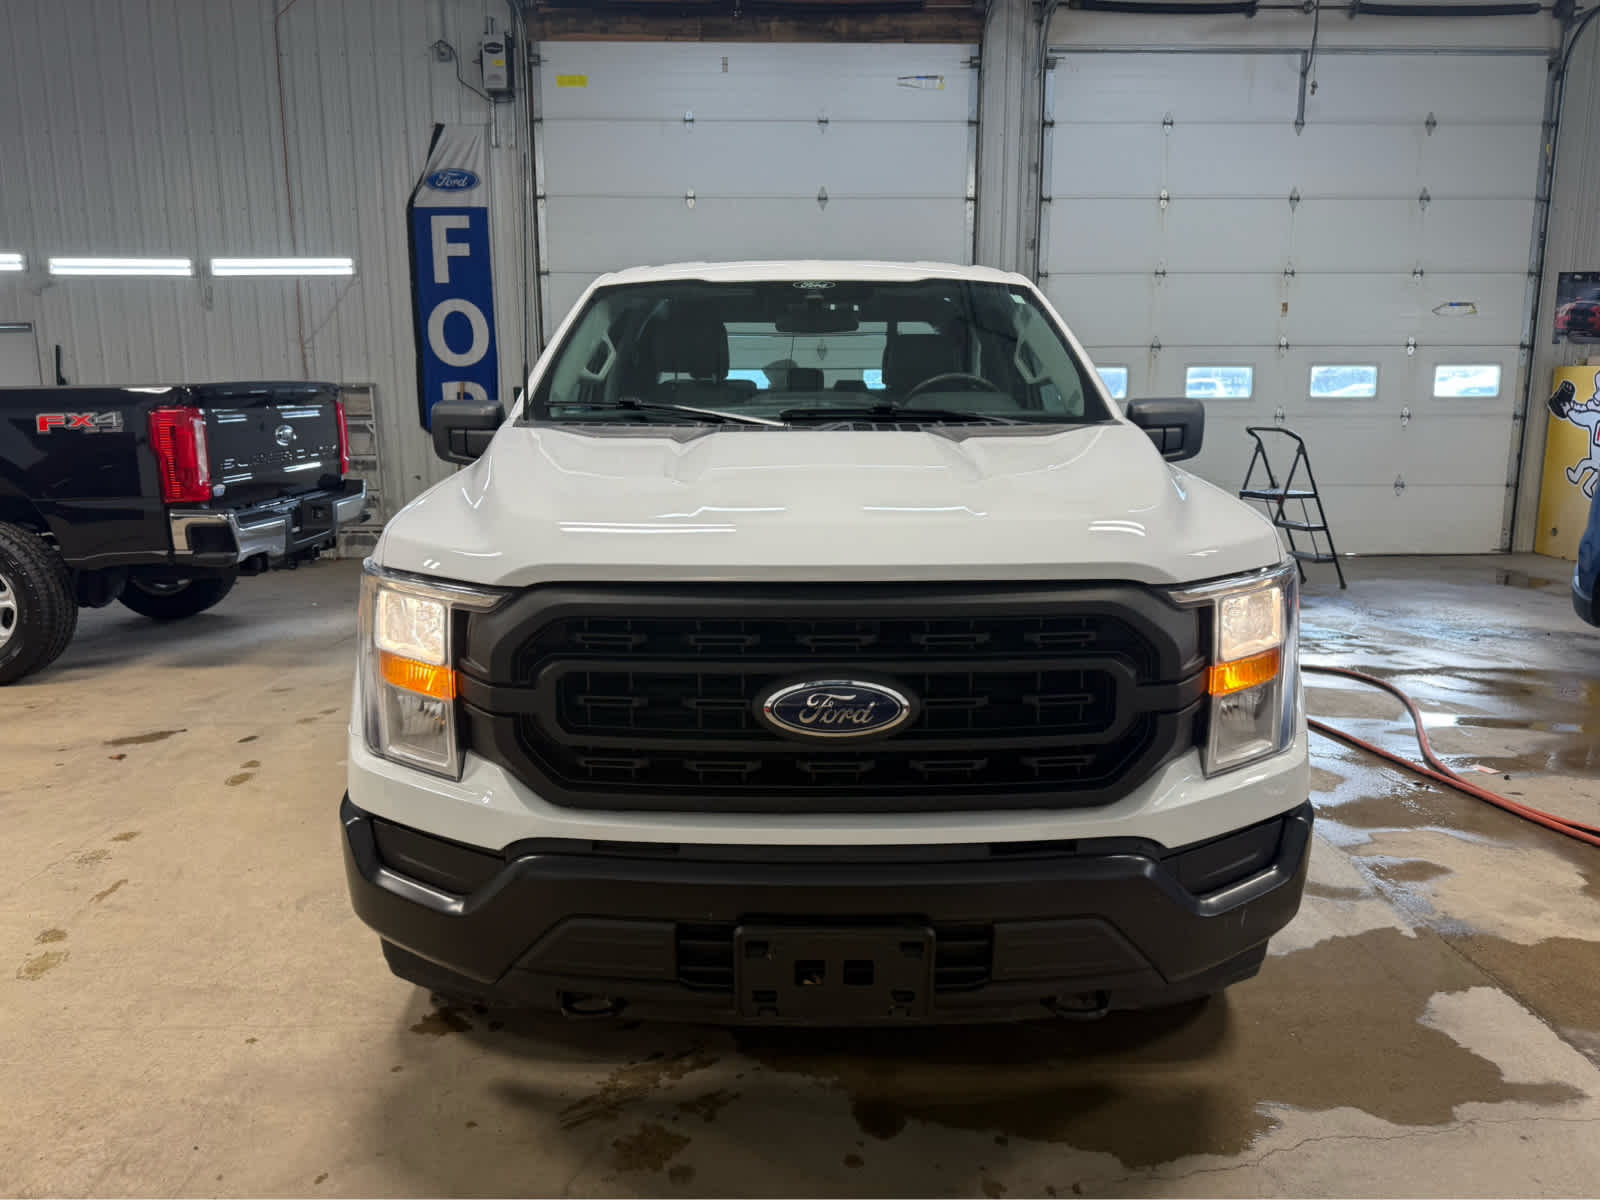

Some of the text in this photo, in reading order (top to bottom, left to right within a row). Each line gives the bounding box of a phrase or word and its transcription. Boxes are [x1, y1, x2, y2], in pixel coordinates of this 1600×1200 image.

[435, 172, 469, 187] Ford
[427, 215, 490, 400] FO
[36, 412, 123, 433] FX4
[799, 692, 878, 724] Ford
